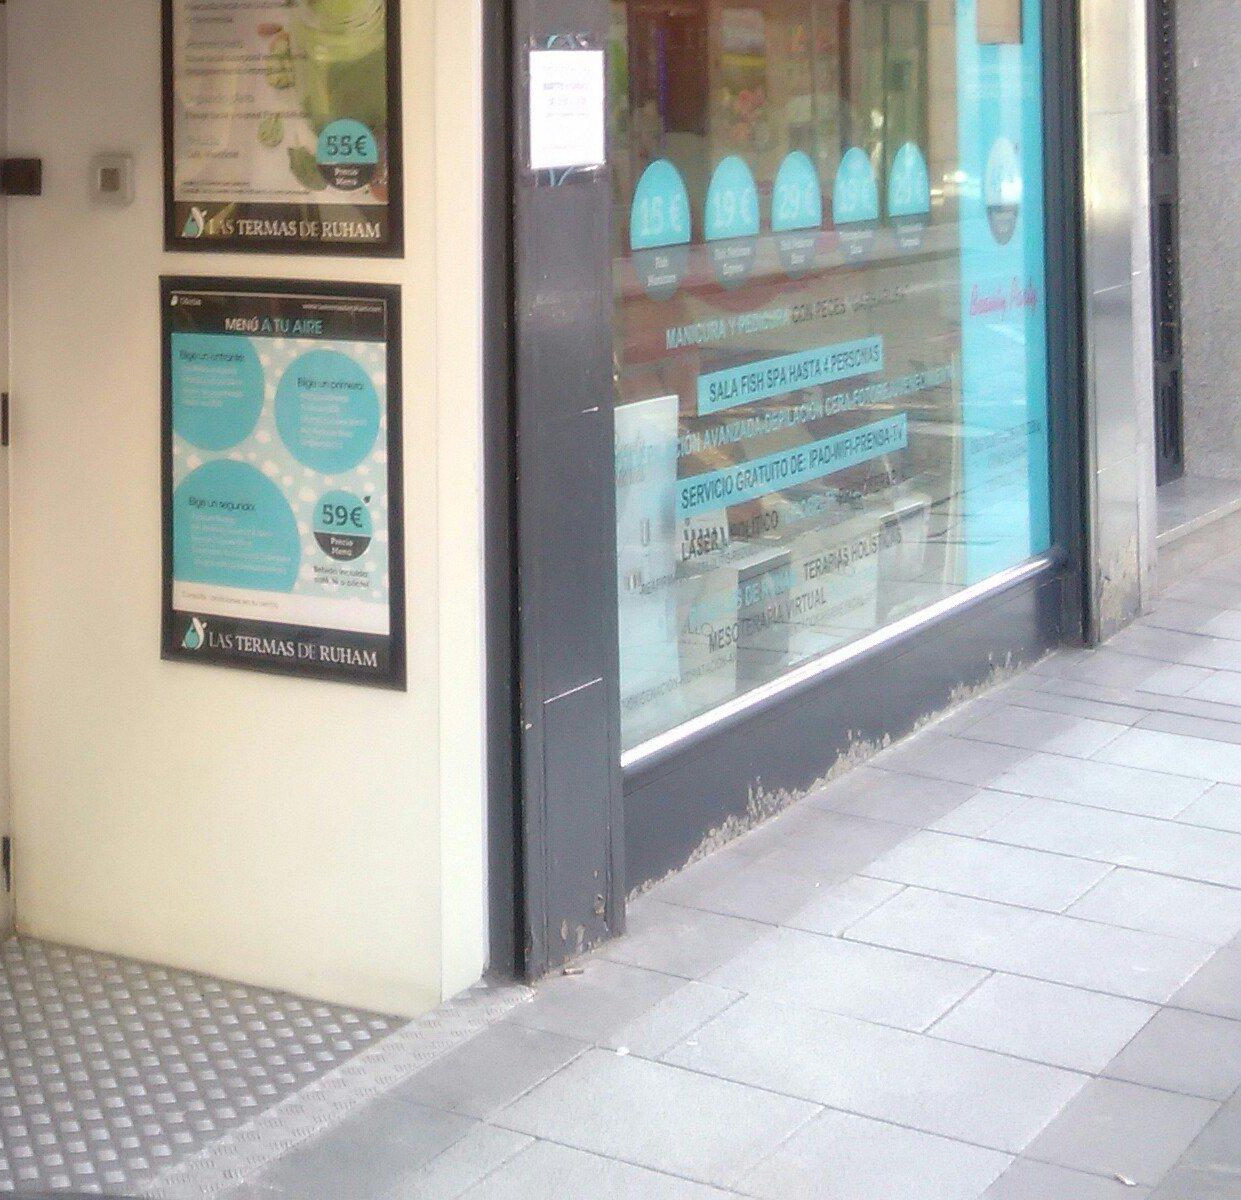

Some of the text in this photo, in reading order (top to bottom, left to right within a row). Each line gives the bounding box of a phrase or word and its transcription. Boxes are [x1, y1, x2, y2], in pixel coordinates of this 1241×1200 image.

[326, 134, 368, 157] 55€
[237, 218, 296, 238] TERMAS
[300, 220, 319, 238] DE
[321, 218, 382, 240] RUHAM
[224, 316, 323, 335] MENÚ A TU AIRE
[709, 377, 739, 404] SALA
[740, 369, 765, 396] FISH
[766, 362, 788, 388] SPA
[788, 356, 823, 384] HASTA
[680, 476, 734, 510] SERVICIO
[735, 460, 789, 493] GRATUITO
[322, 503, 365, 529] 59€
[803, 548, 848, 582] TERAPIAS
[784, 586, 827, 622] VIRTUAL
[209, 632, 379, 668] LAS TERMAS DE RUHAM
